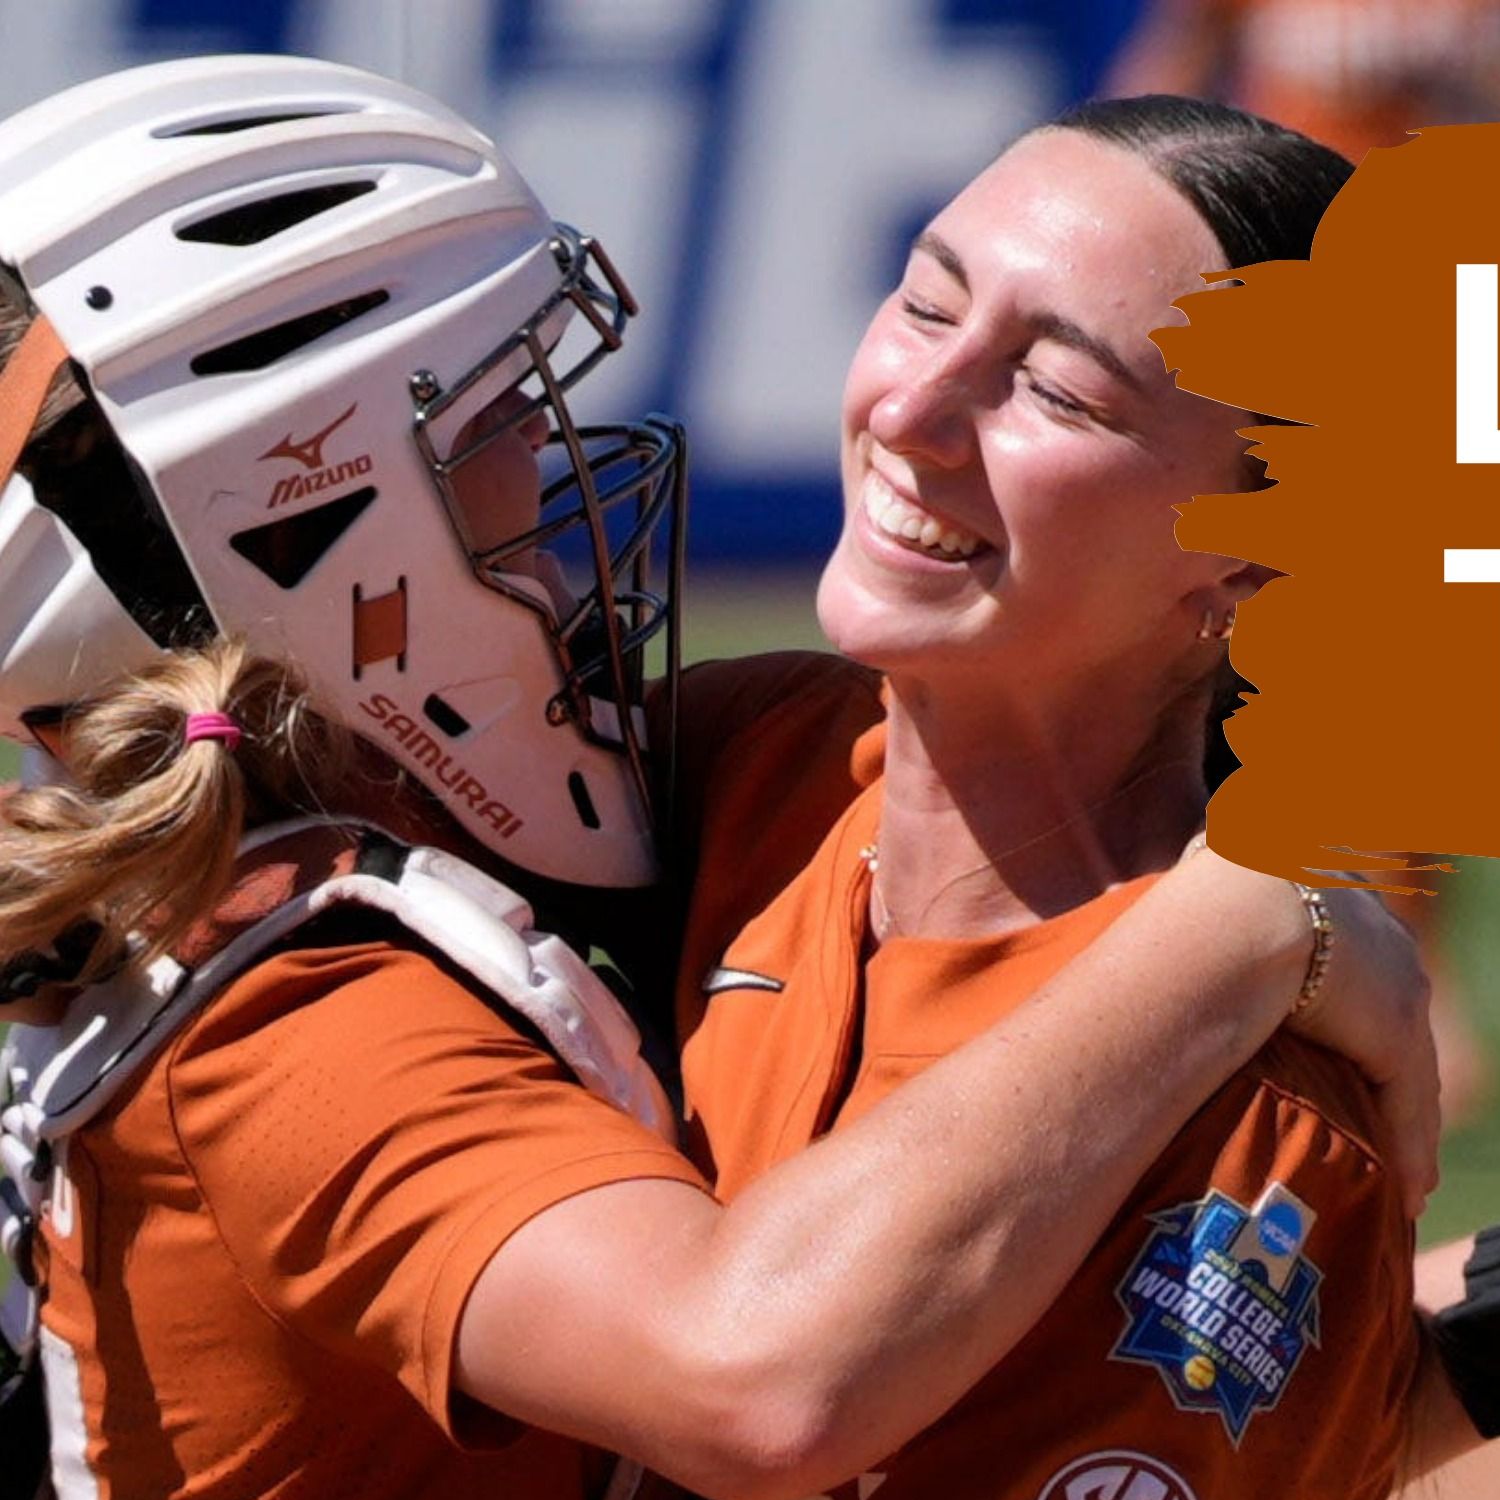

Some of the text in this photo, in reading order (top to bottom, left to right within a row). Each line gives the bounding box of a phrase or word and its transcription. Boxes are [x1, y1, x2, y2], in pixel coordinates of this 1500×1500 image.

[359, 693, 526, 839] SAMURAI
[1130, 1266, 1286, 1393] WORLD SERIES
[1186, 1261, 1283, 1345] COLLEGE
